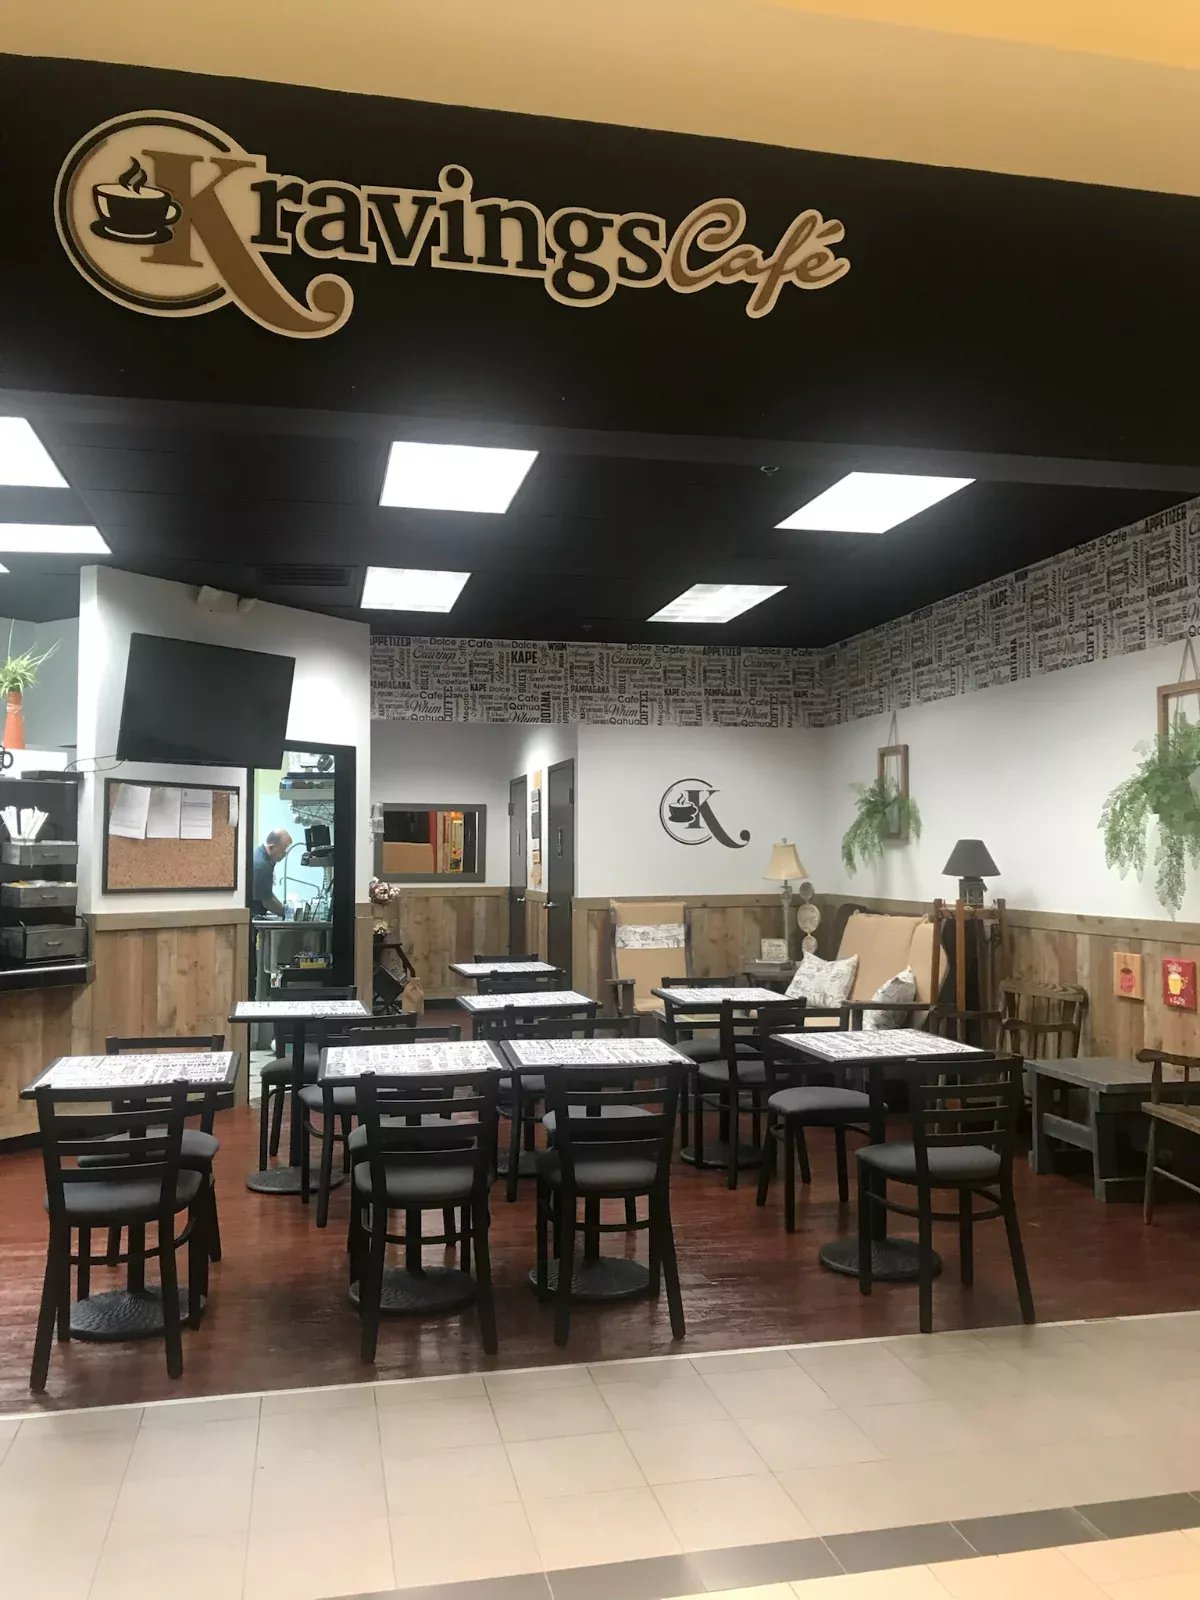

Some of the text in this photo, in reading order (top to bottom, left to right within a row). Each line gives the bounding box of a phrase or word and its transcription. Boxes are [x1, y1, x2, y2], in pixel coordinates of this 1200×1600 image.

[141, 148, 847, 336] Kravings Café
[1105, 531, 1127, 547] Cafe
[1075, 542, 1096, 557] Dolce
[627, 643, 652, 651] Dolce
[662, 646, 686, 654] Cafe
[702, 647, 742, 656] APPETIZER
[791, 648, 814, 656] Cafe
[413, 645, 457, 663] Cravings
[511, 650, 537, 664] KAPE
[470, 683, 487, 691] KAPE
[420, 691, 443, 699] Cafe
[518, 694, 539, 702] Cafe
[409, 700, 442, 713] Whim
[444, 686, 453, 722] COFFEE
[509, 702, 540, 710] Qahua
[541, 691, 551, 723] BOTANA
[609, 704, 638, 716] Whim
[640, 691, 649, 726] COFFEE
[411, 713, 445, 722] Qahua
[509, 711, 539, 723] Whim
[609, 717, 640, 725] Qahua
